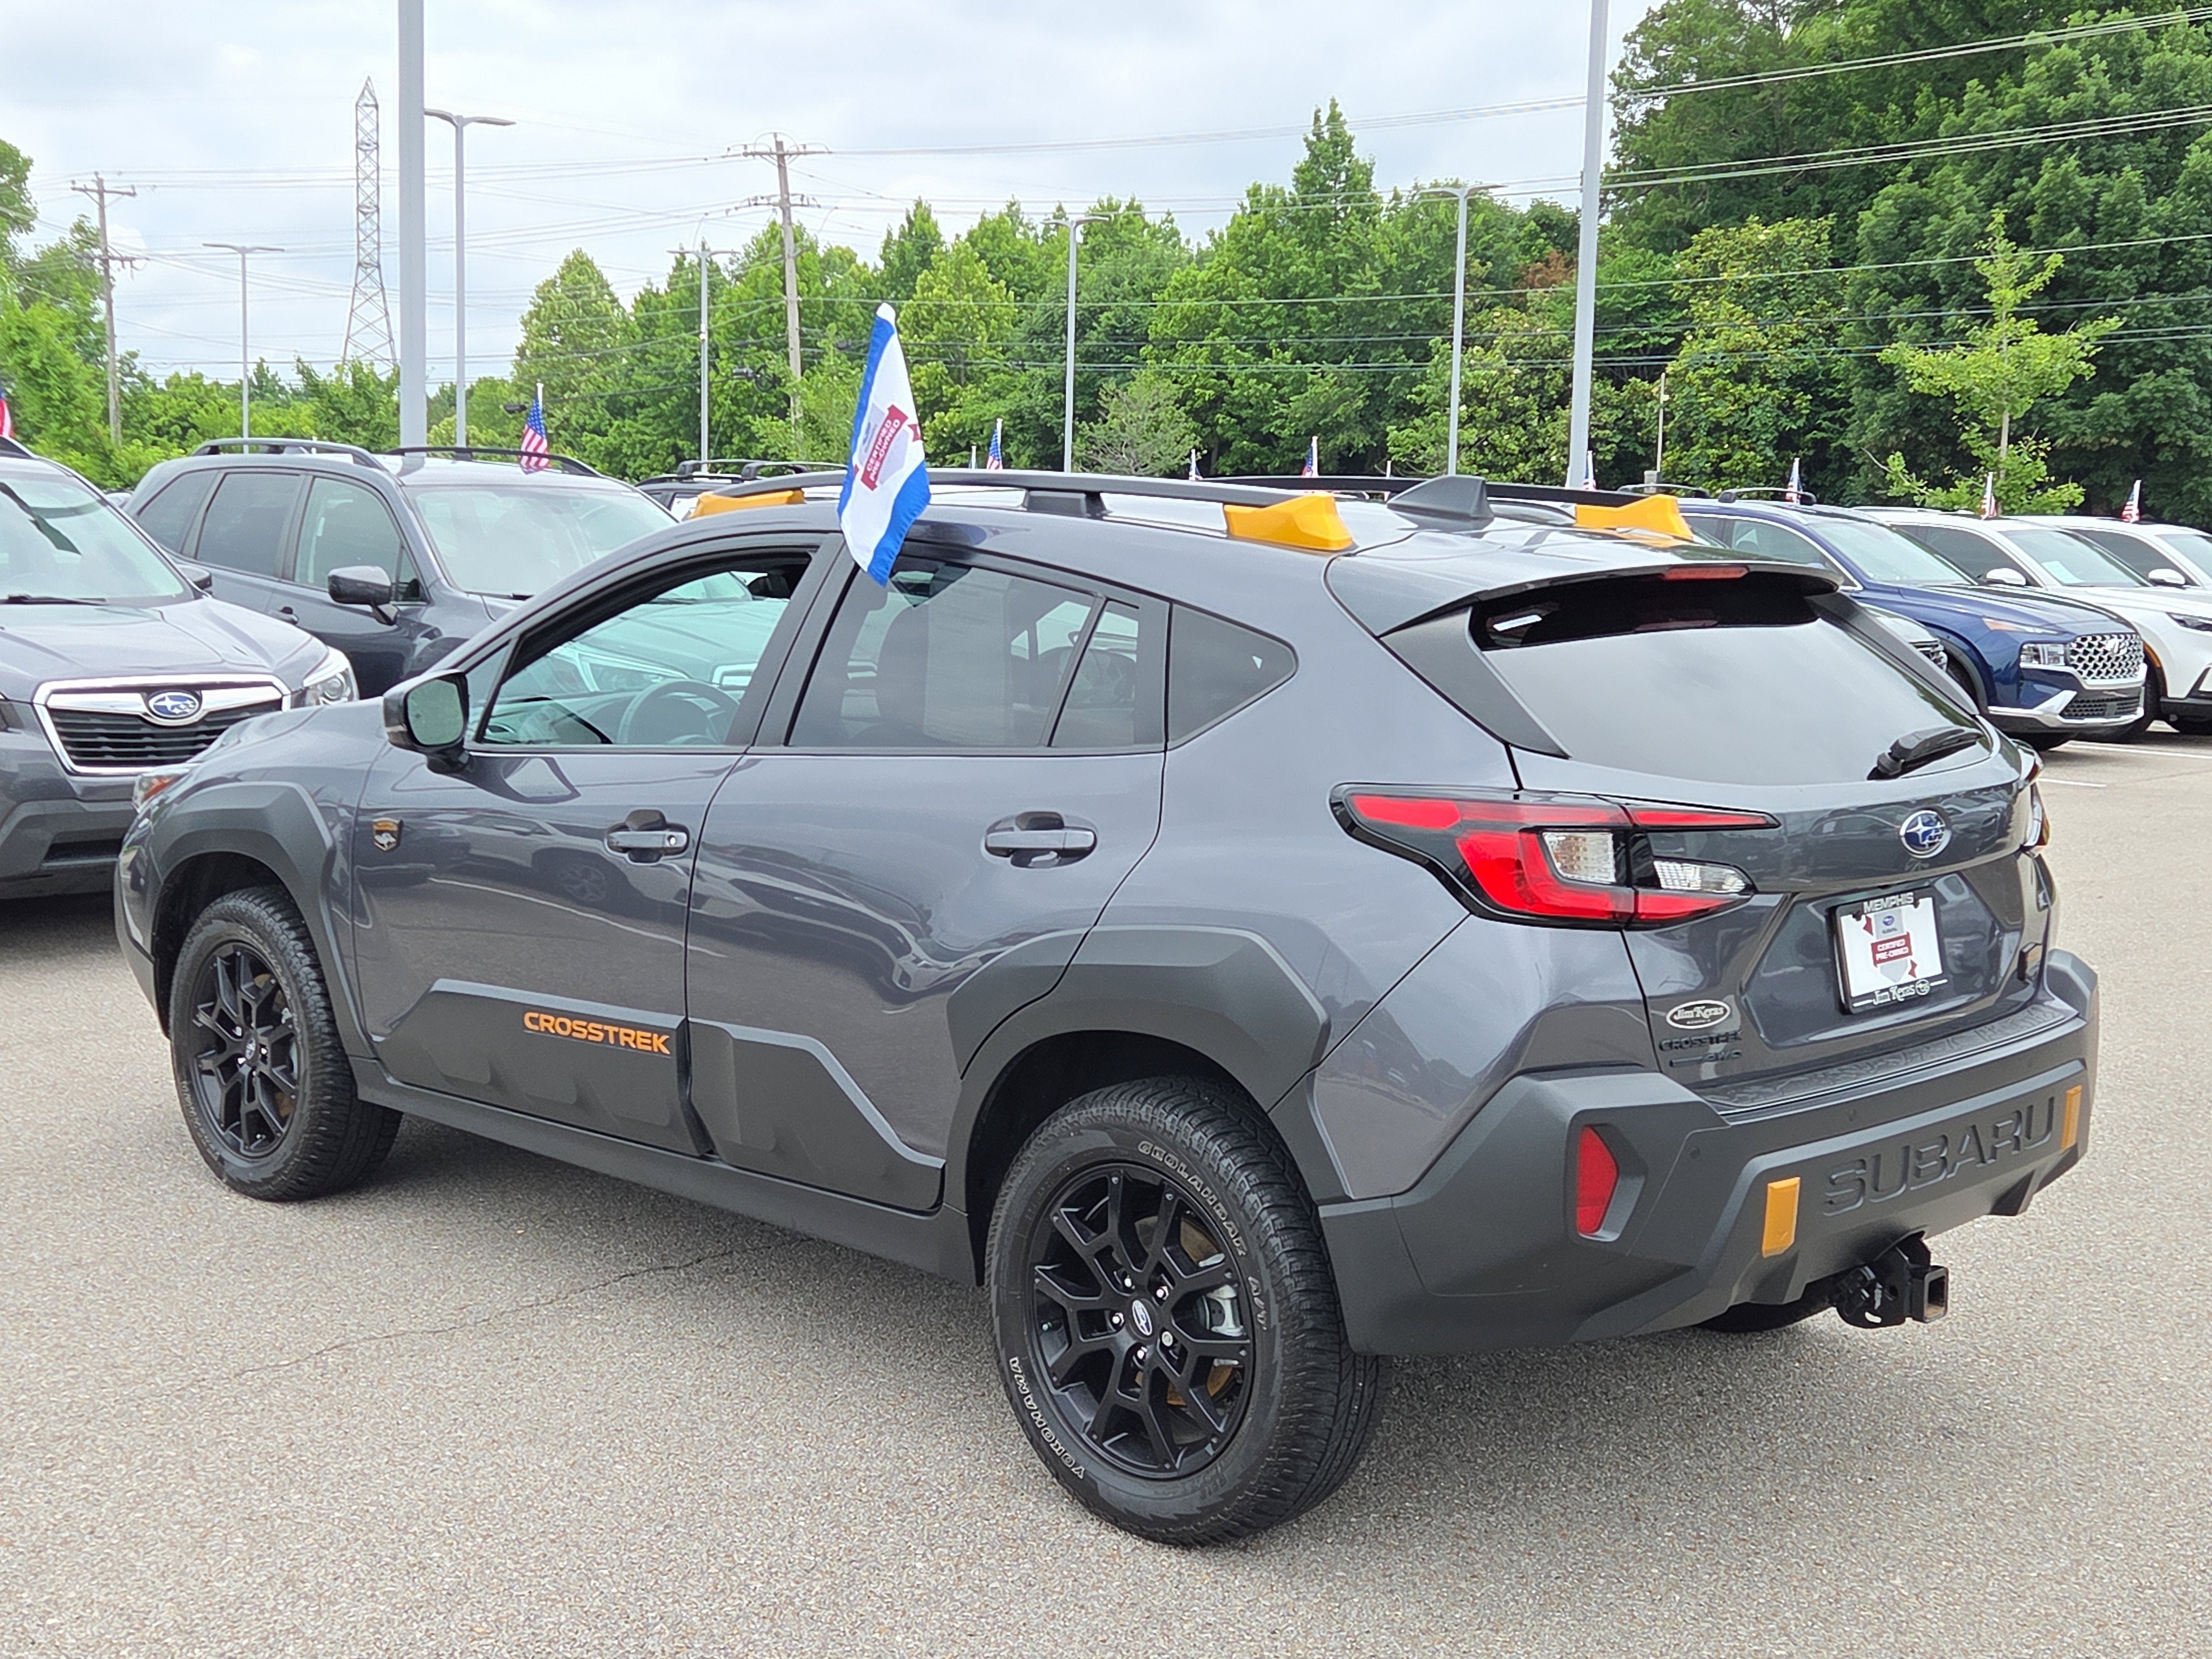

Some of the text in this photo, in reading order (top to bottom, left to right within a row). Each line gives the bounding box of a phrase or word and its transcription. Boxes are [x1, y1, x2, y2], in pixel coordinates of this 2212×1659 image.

[866, 419, 892, 472] CERTIFIED
[869, 419, 901, 481] PRE-OWNED
[1863, 892, 1914, 914] MEMPHIS
[523, 1011, 671, 1055] CROSSTREK
[1822, 1096, 2055, 1217] SUBARU
[1137, 1140, 1248, 1256] GEOLANDAR
[1009, 1356, 1085, 1480] YOKOHAMA
